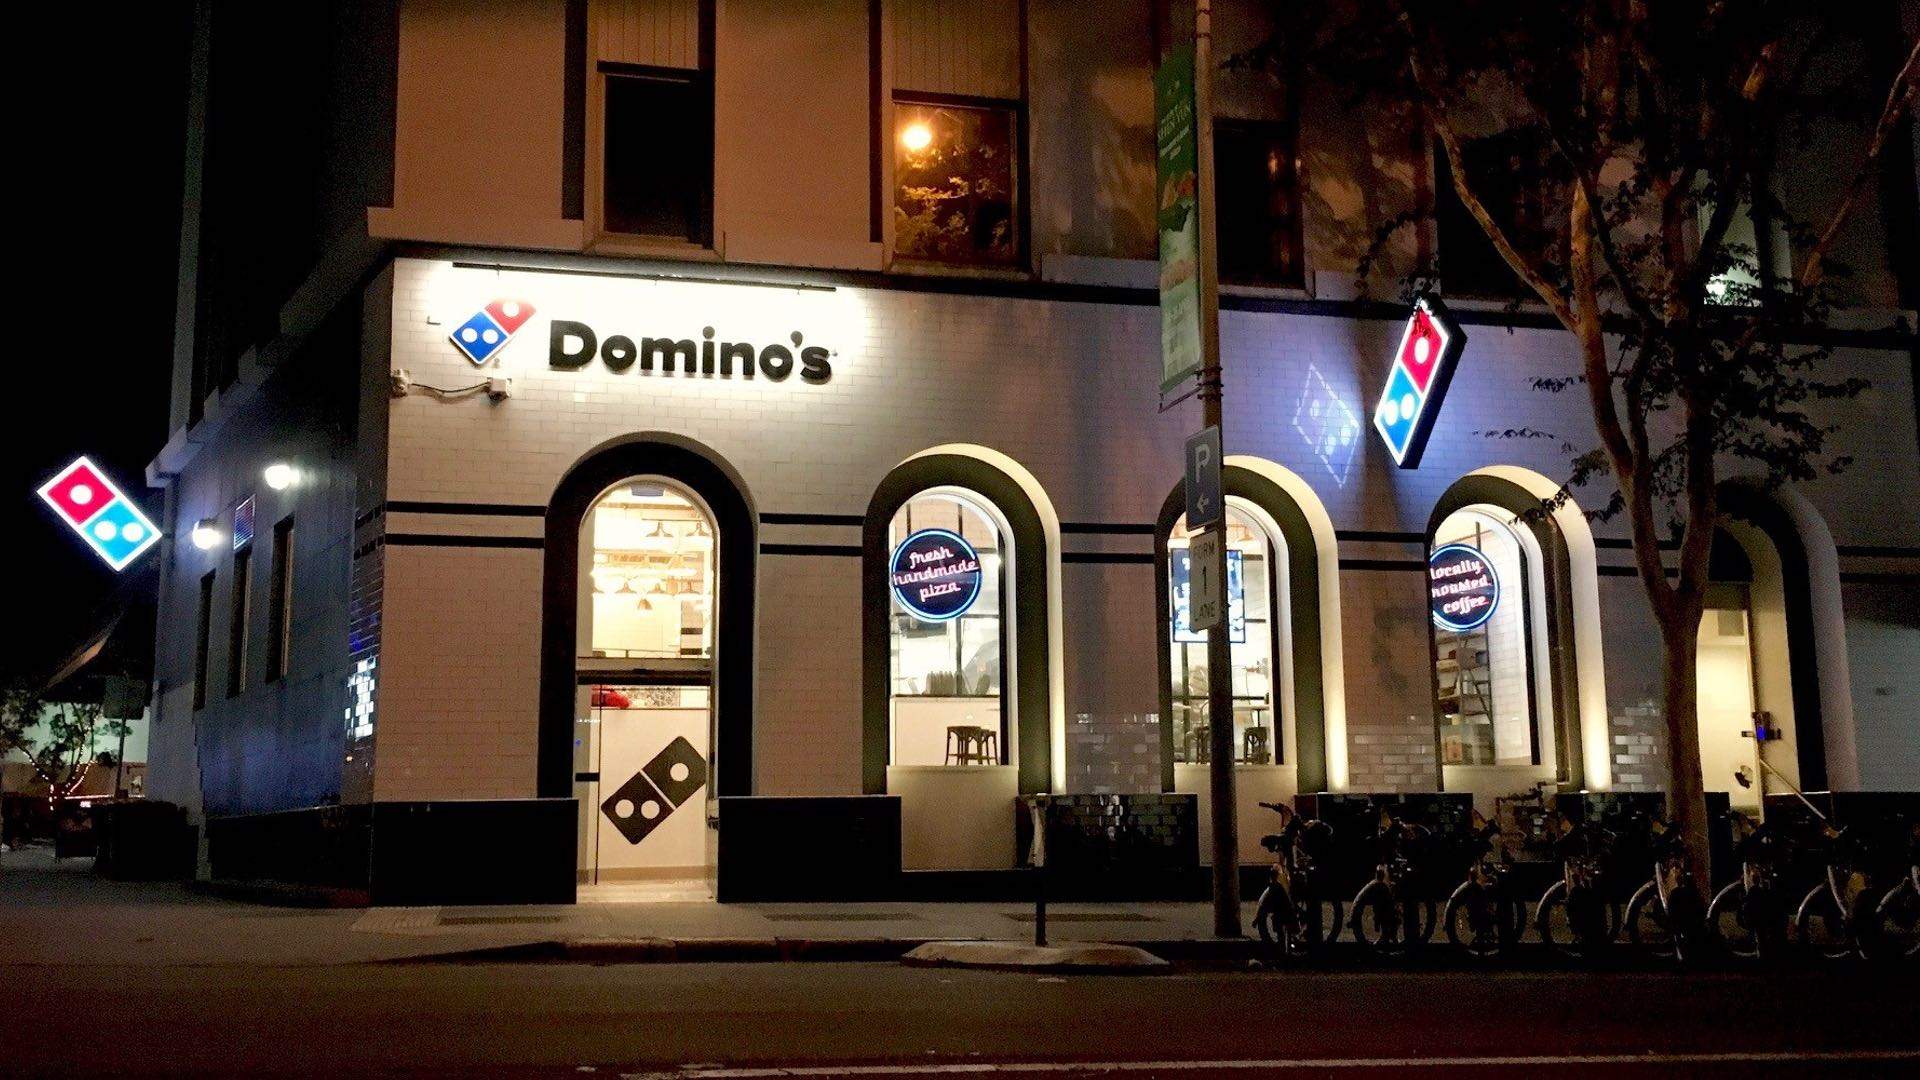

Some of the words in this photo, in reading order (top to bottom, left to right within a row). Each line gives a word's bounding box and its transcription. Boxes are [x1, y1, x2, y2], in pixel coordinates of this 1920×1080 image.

[549, 319, 832, 385] Domino's
[1195, 443, 1211, 483] P
[909, 546, 955, 569] fresh
[893, 559, 979, 586] handmade
[920, 581, 961, 603] pizza
[1443, 596, 1490, 615] coffee
